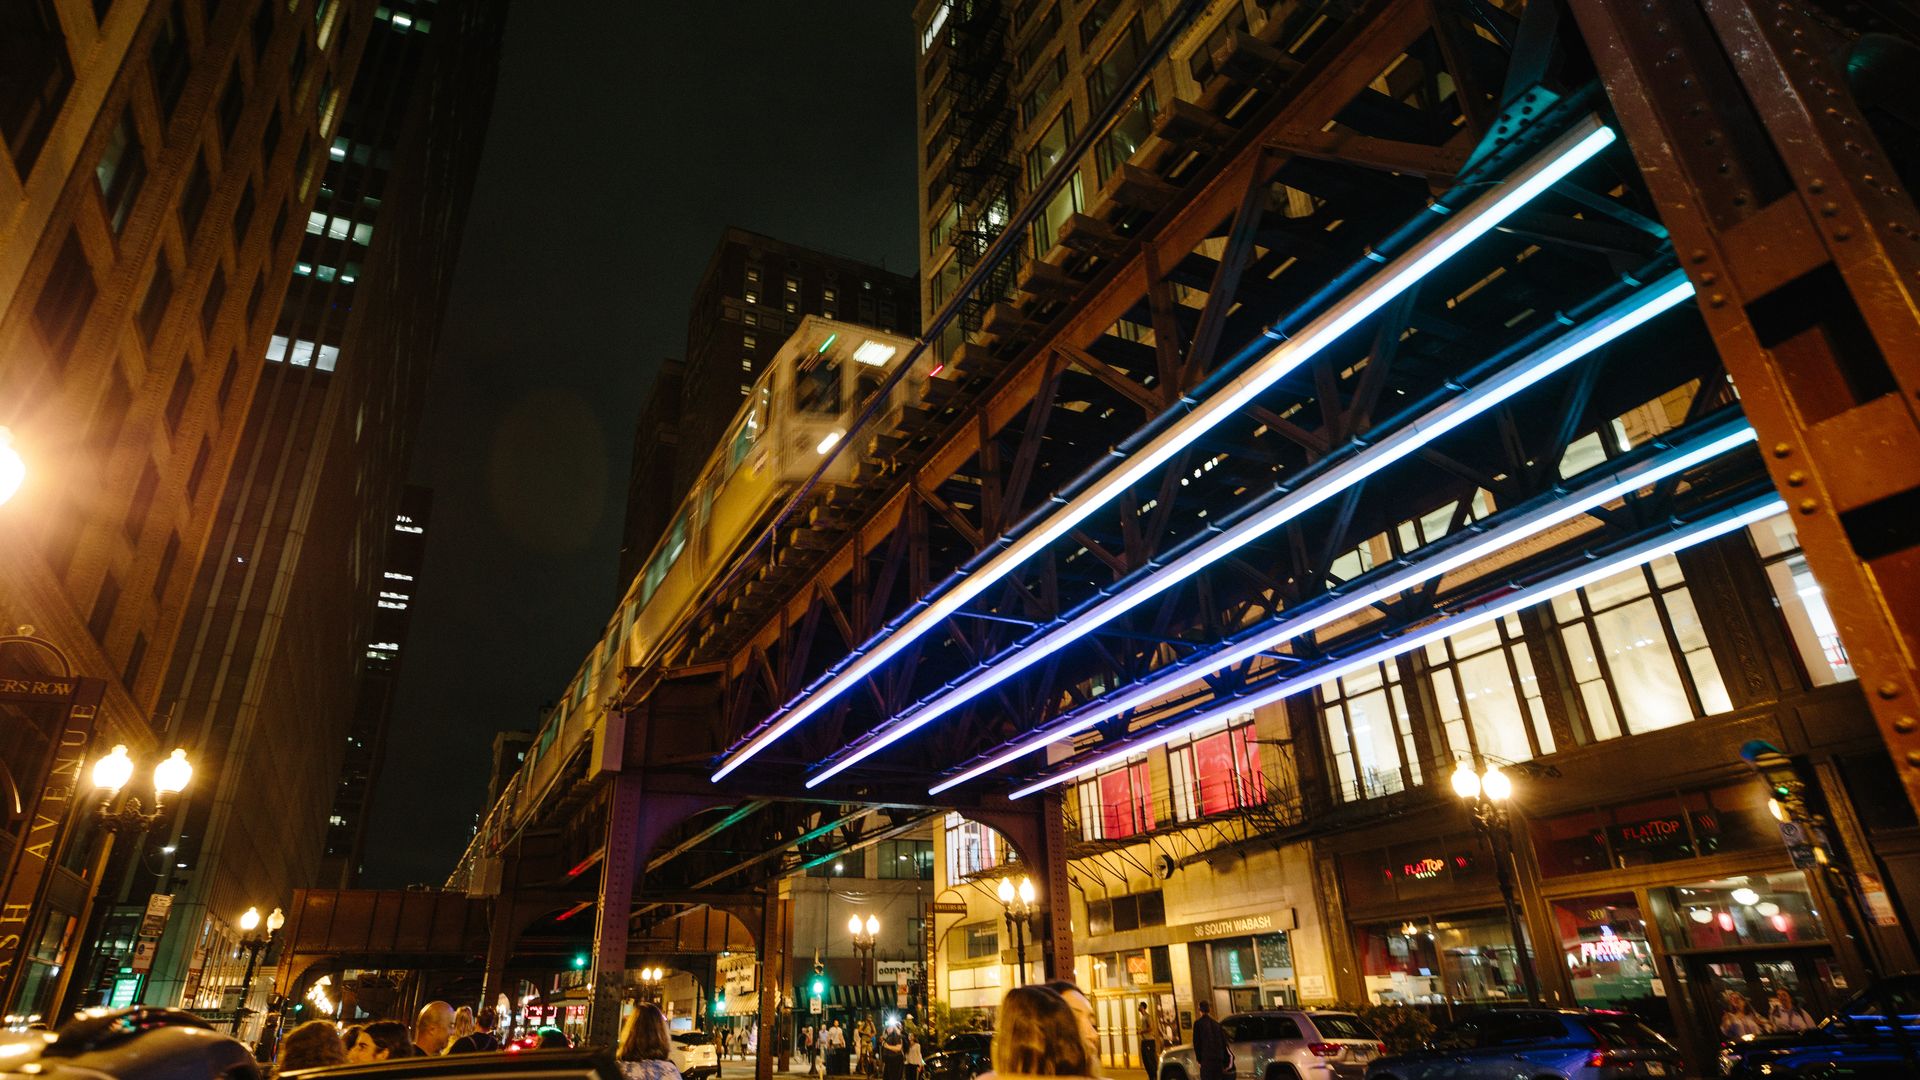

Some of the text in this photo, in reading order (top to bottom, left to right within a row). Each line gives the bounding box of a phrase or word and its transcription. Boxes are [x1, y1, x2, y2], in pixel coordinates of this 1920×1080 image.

[31, 681, 71, 695] ROW
[25, 704, 97, 861] AVENUE
[927, 911, 935, 966] AVENUE
[1194, 915, 1272, 936] 36 SOUTH WABASH
